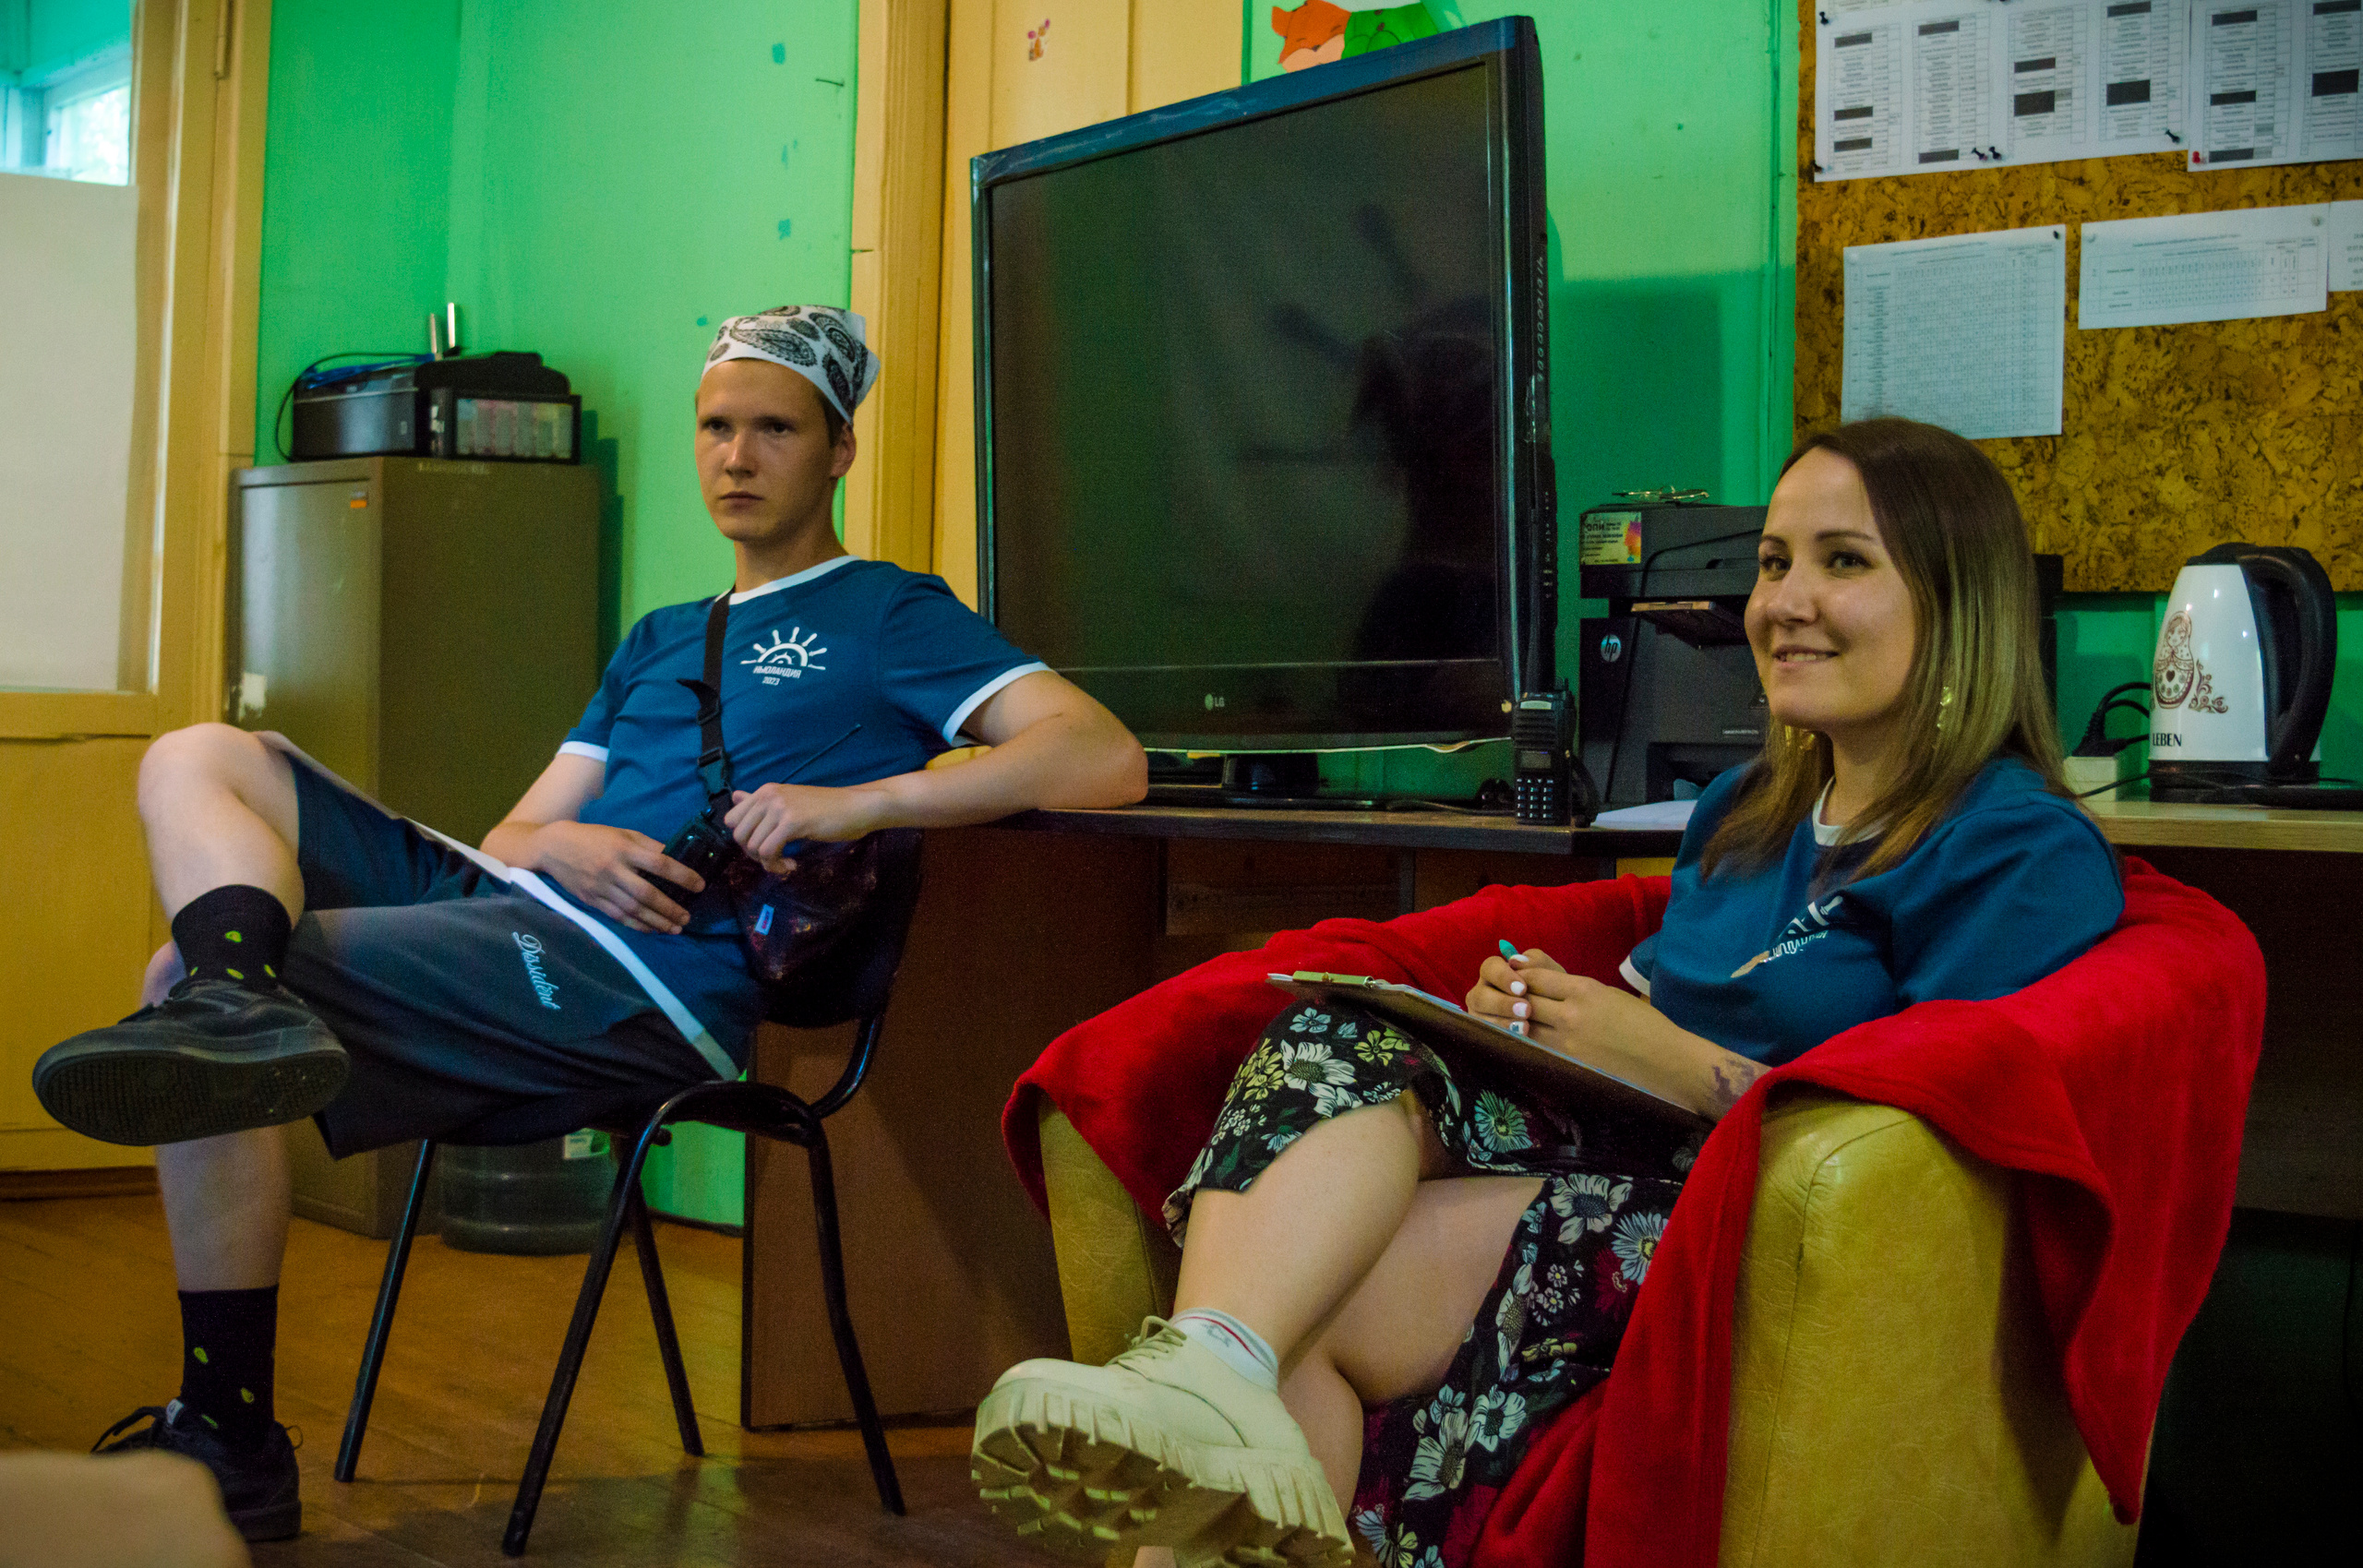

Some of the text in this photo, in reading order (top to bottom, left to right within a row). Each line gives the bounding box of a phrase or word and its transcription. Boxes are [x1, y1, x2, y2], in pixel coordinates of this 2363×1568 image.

[1603, 634, 1618, 663] hp
[752, 665, 802, 679] НЬЮЛАНДИЯ
[762, 676, 781, 686] 2023
[1214, 696, 1225, 708] LG
[2152, 733, 2182, 748] LEBEN
